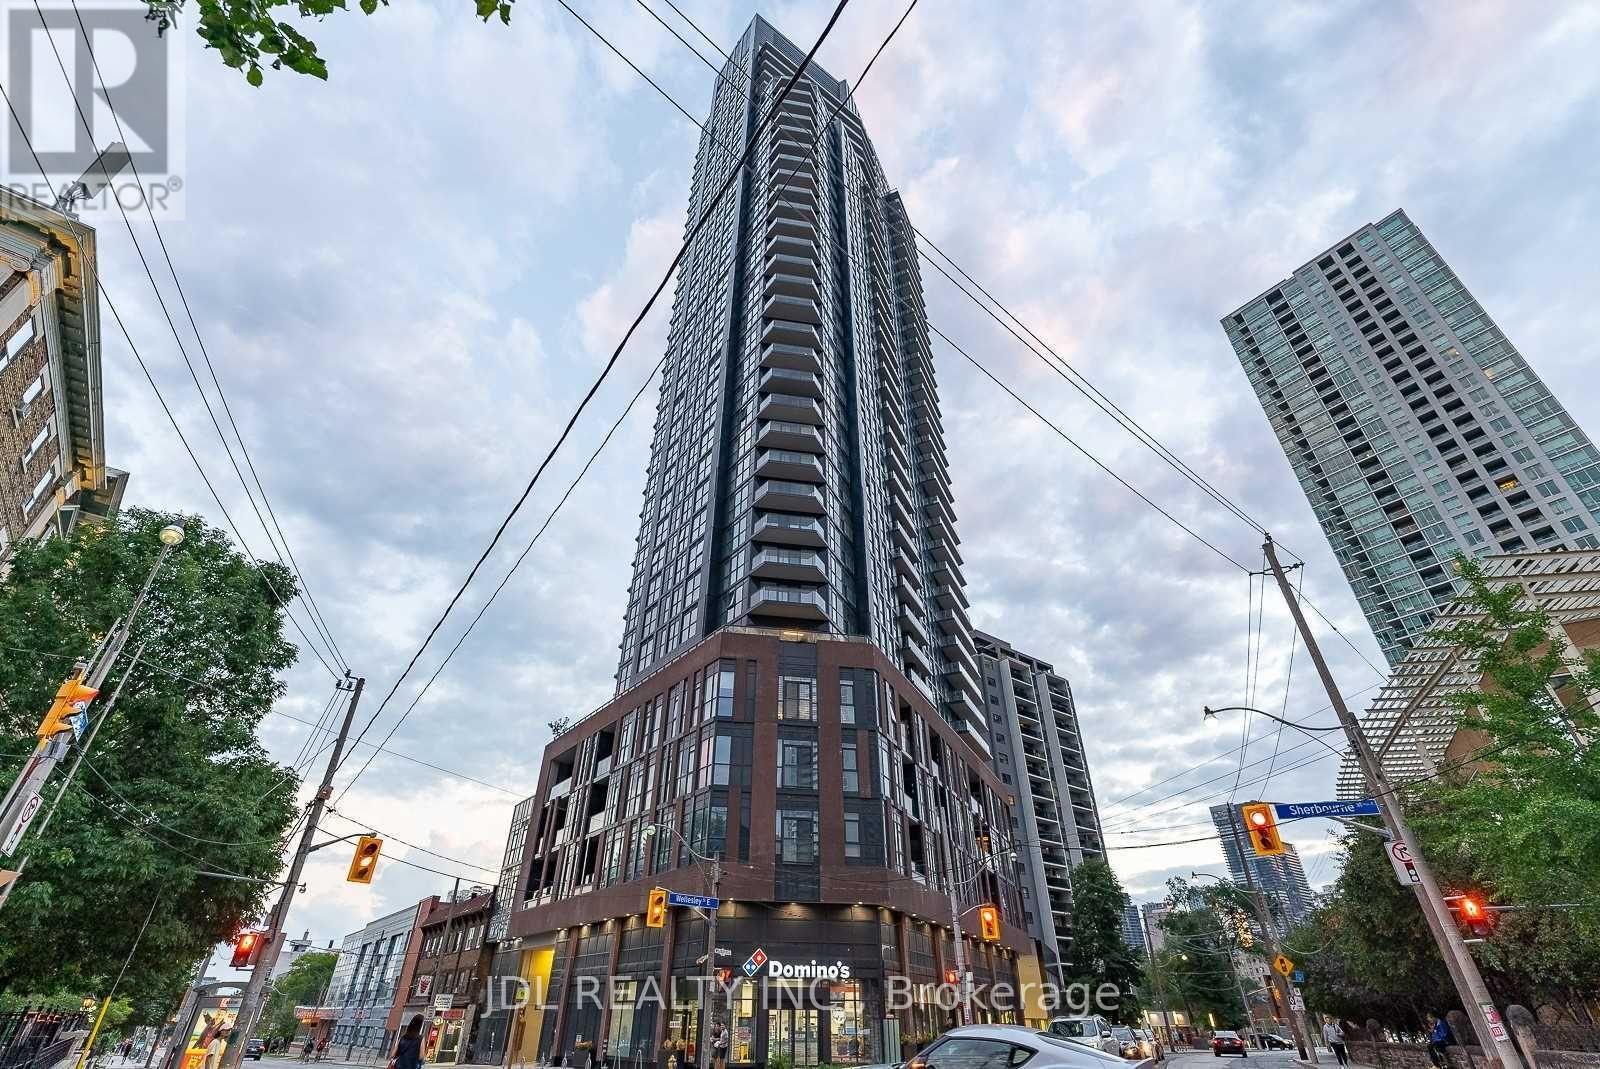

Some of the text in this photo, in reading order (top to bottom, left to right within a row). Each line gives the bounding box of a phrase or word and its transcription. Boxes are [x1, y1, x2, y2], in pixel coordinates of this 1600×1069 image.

[1289, 804, 1355, 815] Sherbourne
[676, 894, 710, 906] Wellesley E
[768, 960, 850, 979] Domino's
